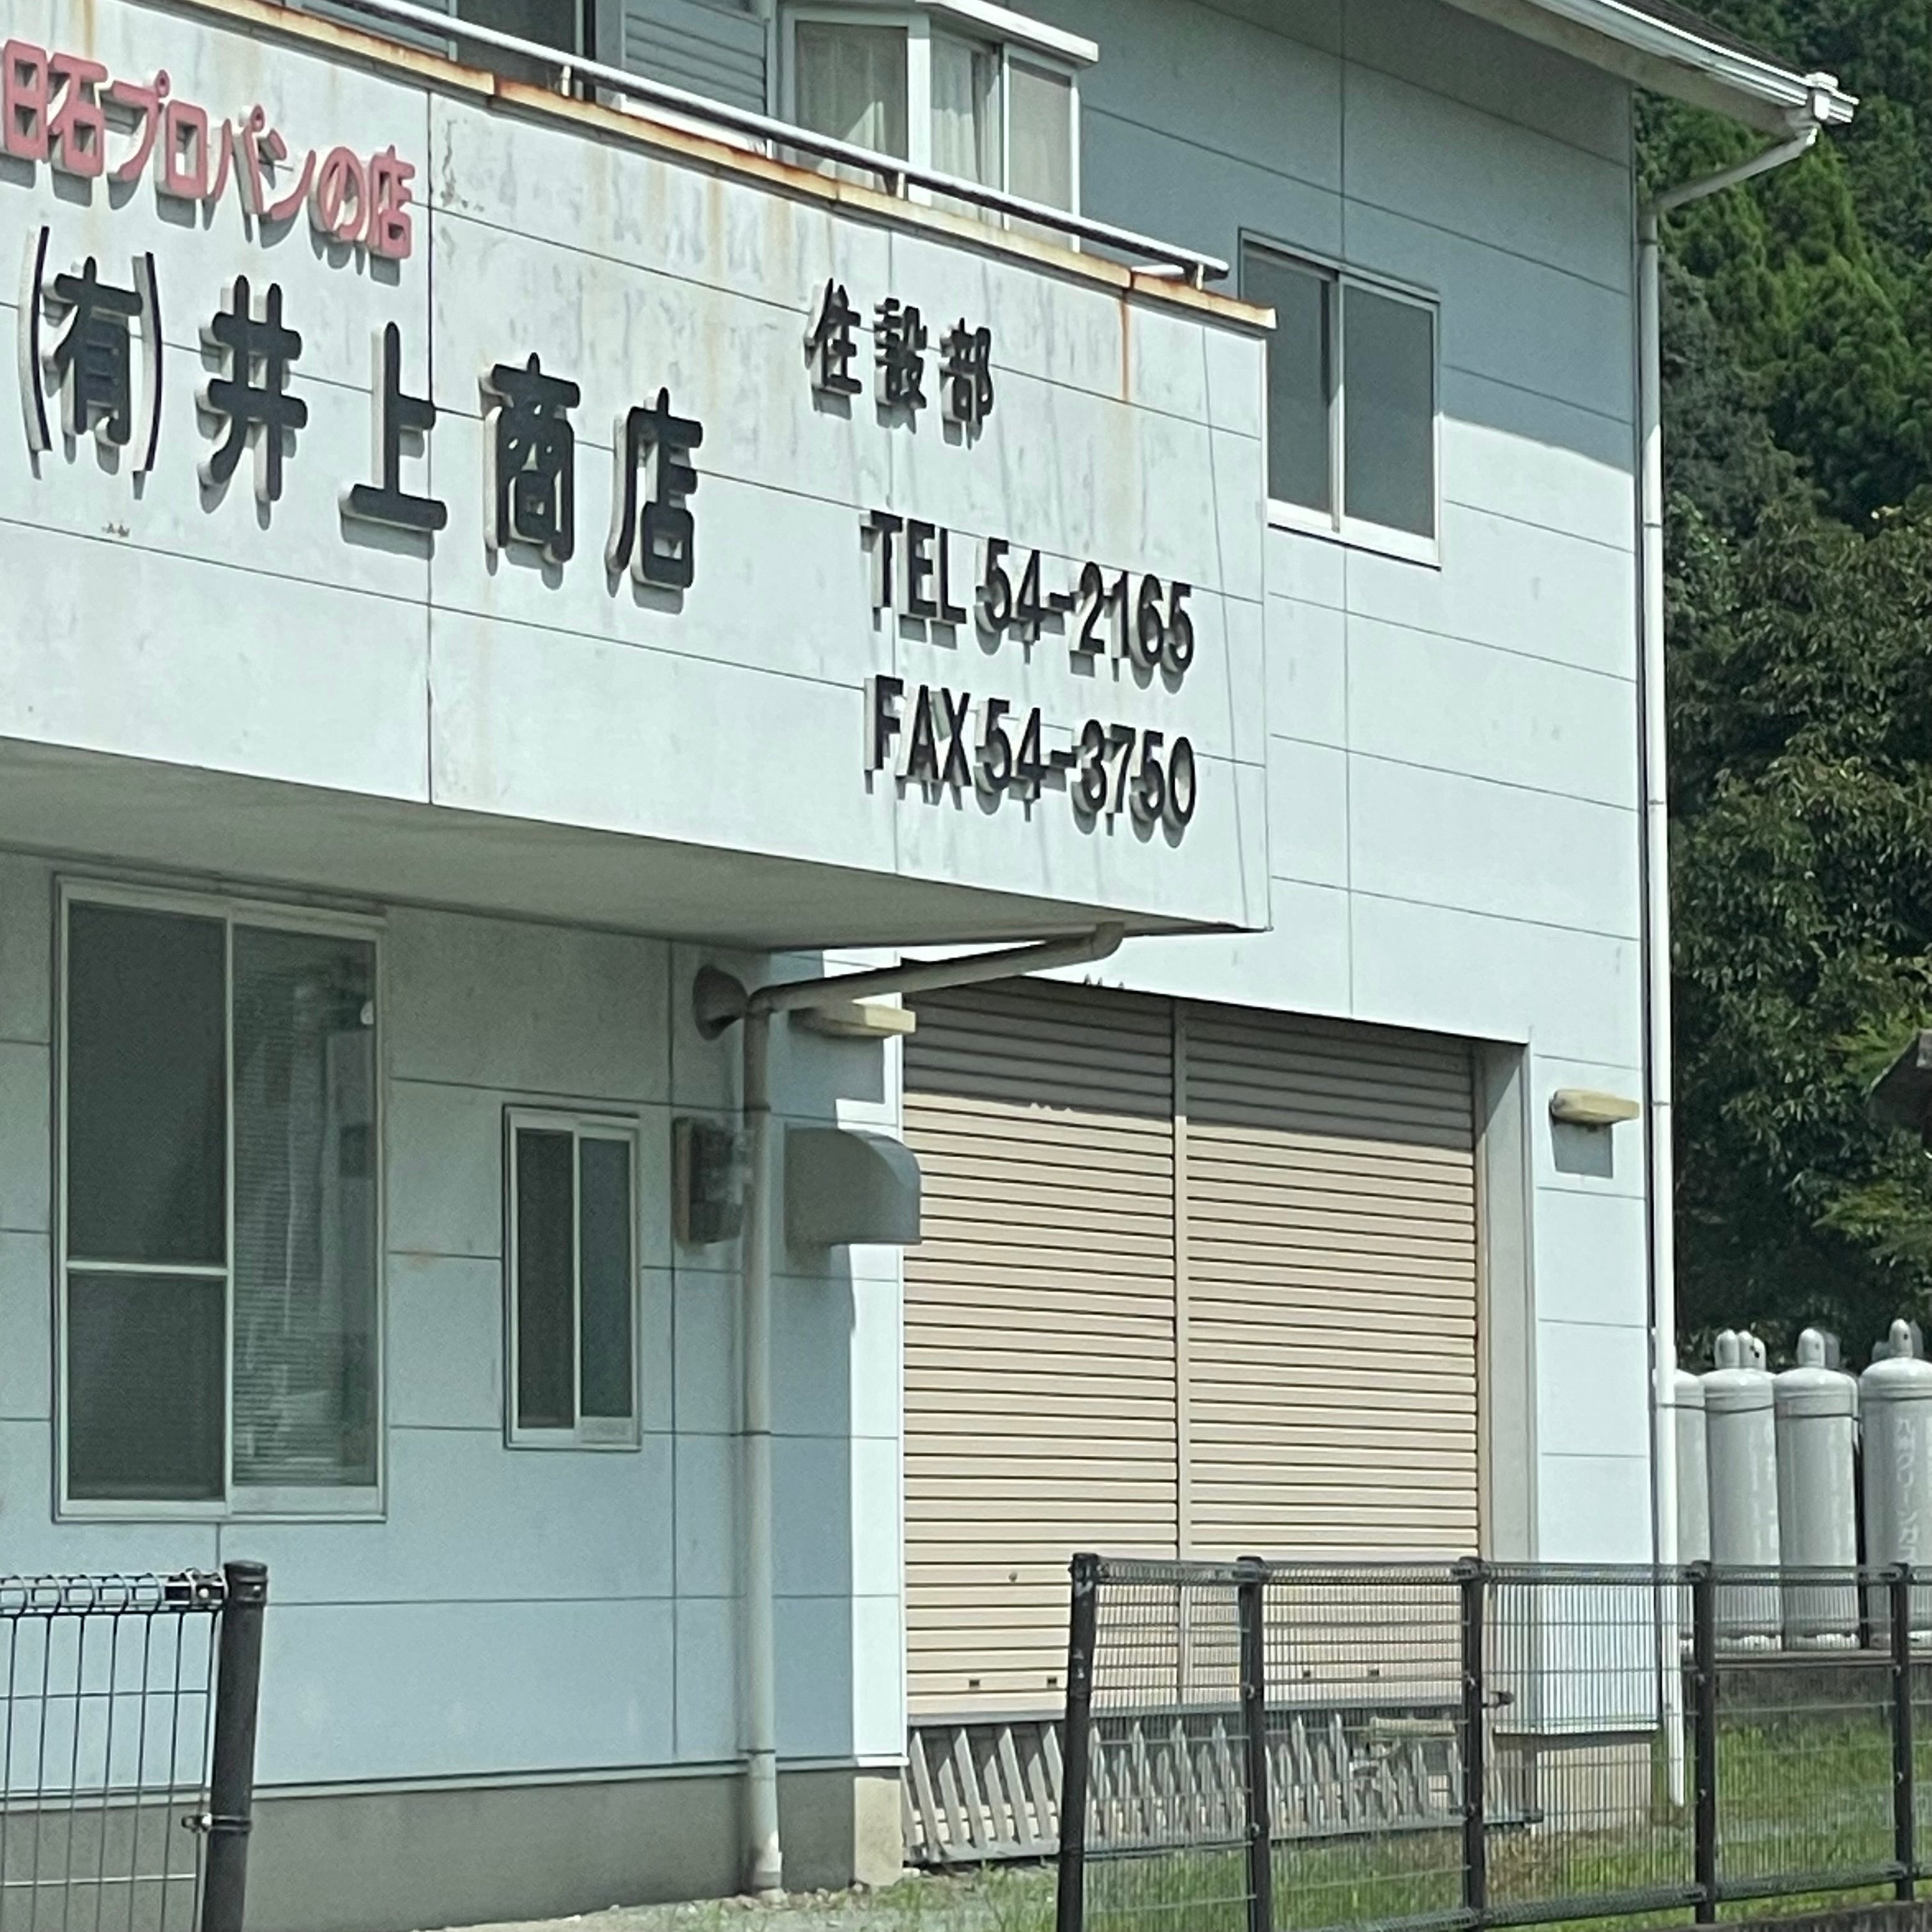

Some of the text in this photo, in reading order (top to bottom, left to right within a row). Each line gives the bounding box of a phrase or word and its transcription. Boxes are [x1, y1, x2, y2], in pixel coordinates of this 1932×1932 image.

[3, 38, 416, 260] 日石プロパンの店
[806, 278, 994, 424] 住設部
[862, 510, 1195, 674] TEL 54-2165
[866, 674, 1197, 829] FAX 54-3750
